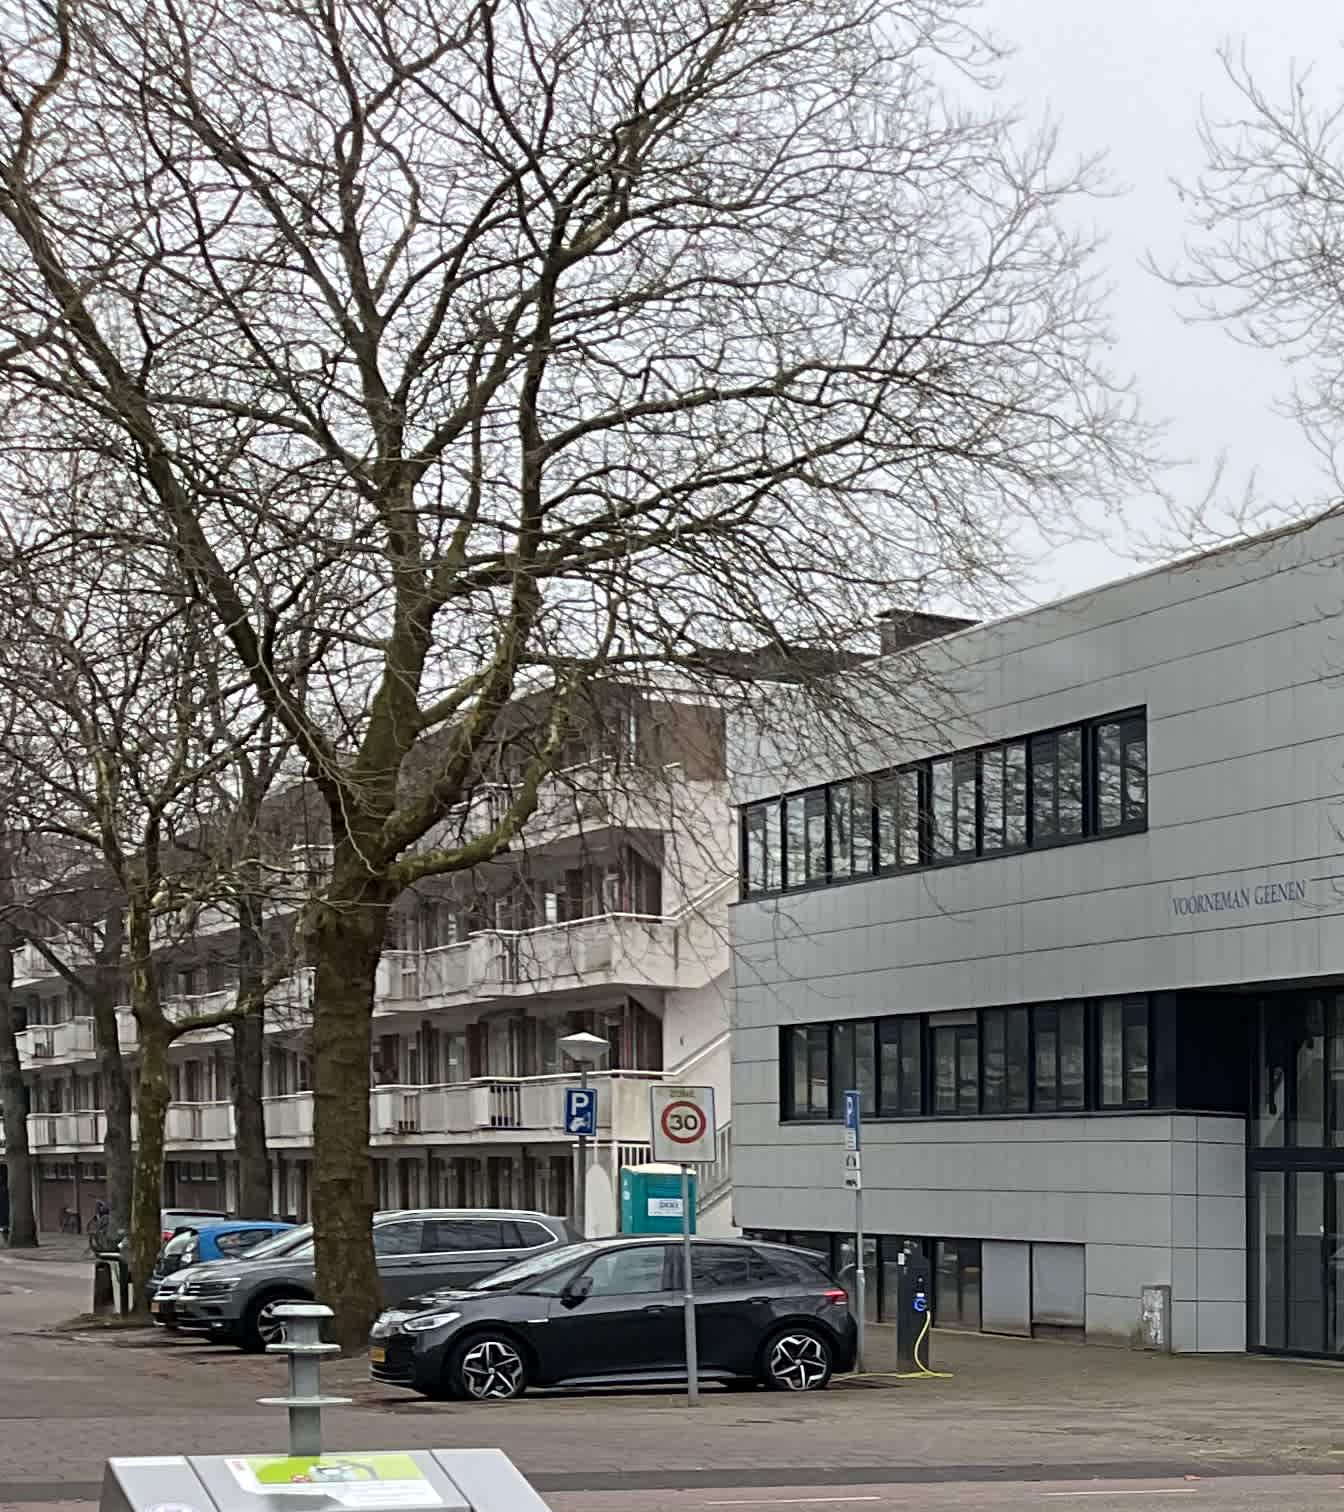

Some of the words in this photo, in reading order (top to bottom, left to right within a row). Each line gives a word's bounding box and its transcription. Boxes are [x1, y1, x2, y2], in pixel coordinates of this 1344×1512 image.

[1172, 888, 1250, 915] VOORNEMAN
[1254, 879, 1306, 905] GEENEN
[571, 1092, 590, 1116] P
[669, 1114, 698, 1131] 30
